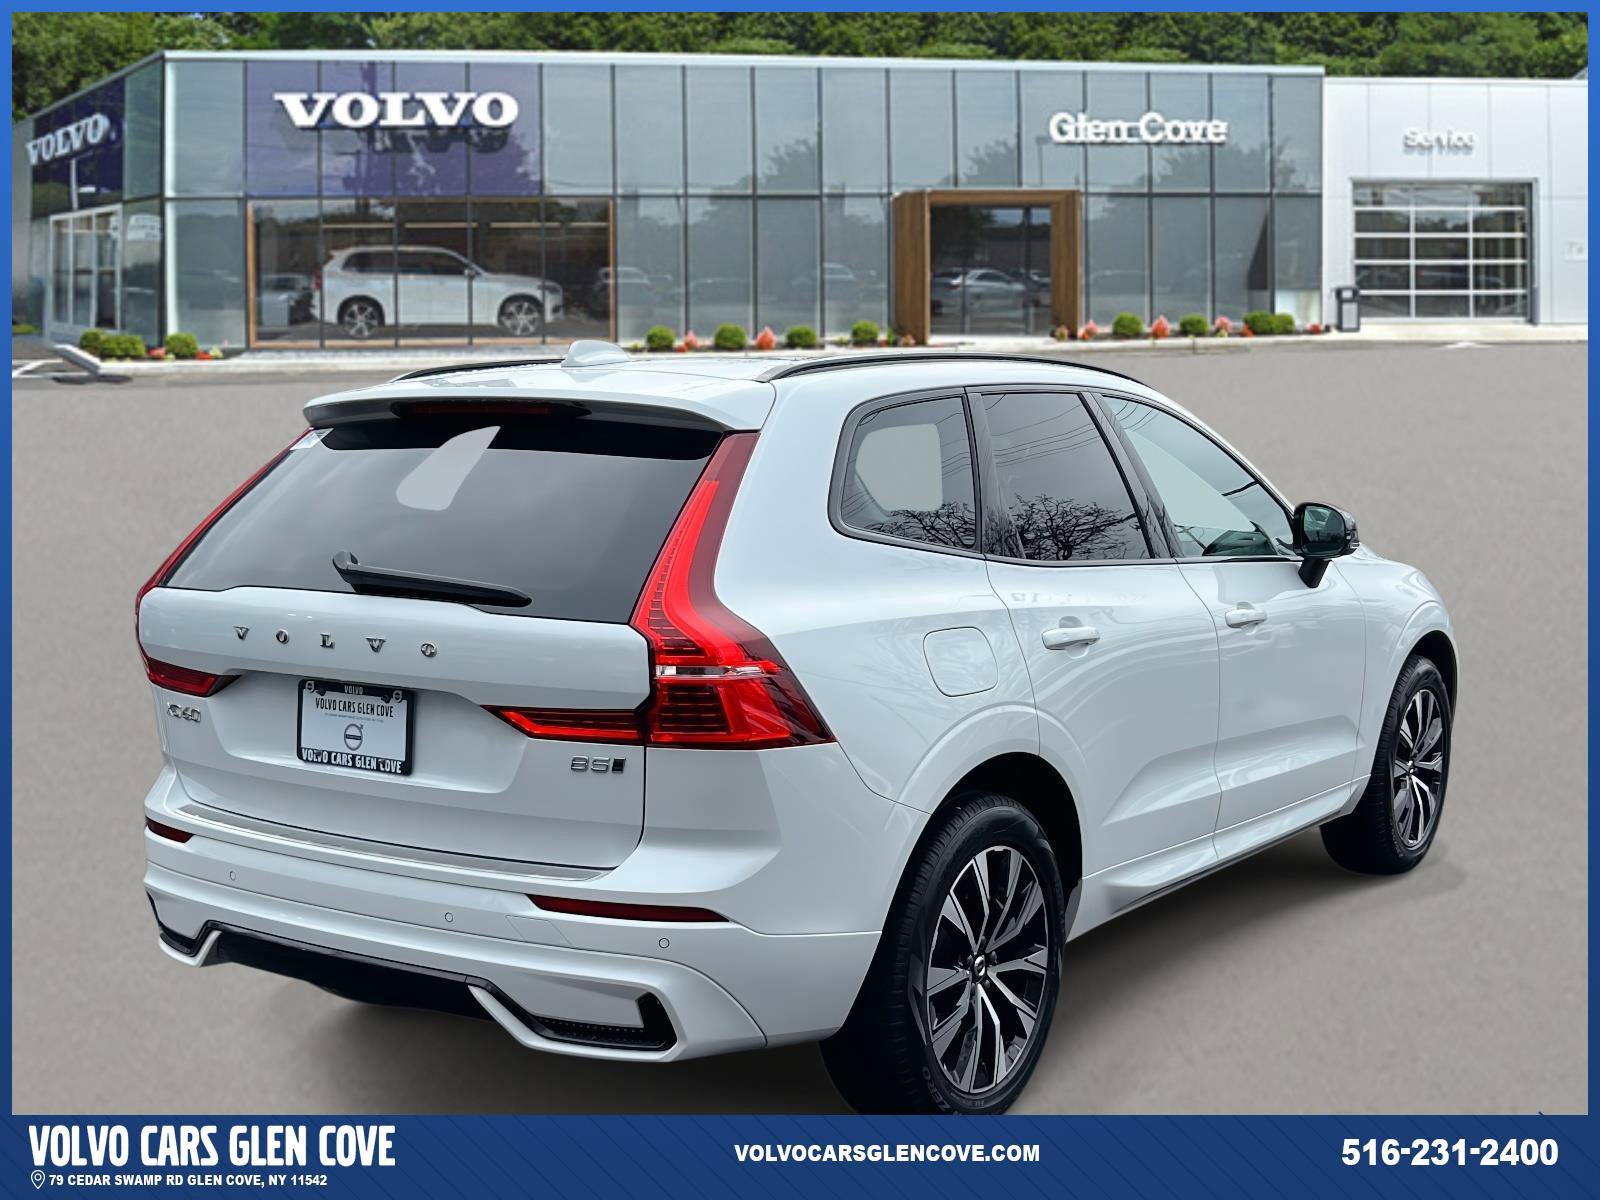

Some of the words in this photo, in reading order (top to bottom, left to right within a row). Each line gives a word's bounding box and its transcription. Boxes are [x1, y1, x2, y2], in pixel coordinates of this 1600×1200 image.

[273, 92, 519, 127] VOLVO
[26, 112, 111, 164] VOLVO
[1049, 111, 1129, 143] Glen
[1139, 111, 1229, 143] Cove
[1402, 128, 1476, 154] Service
[233, 625, 438, 658] VOLVO
[344, 685, 364, 695] VOLVO
[315, 697, 337, 711] VOLVO
[338, 700, 356, 713] CARS
[357, 702, 375, 716] GLEN
[376, 704, 394, 718] COVE
[331, 752, 353, 767] CARS
[355, 755, 377, 770] GLEN
